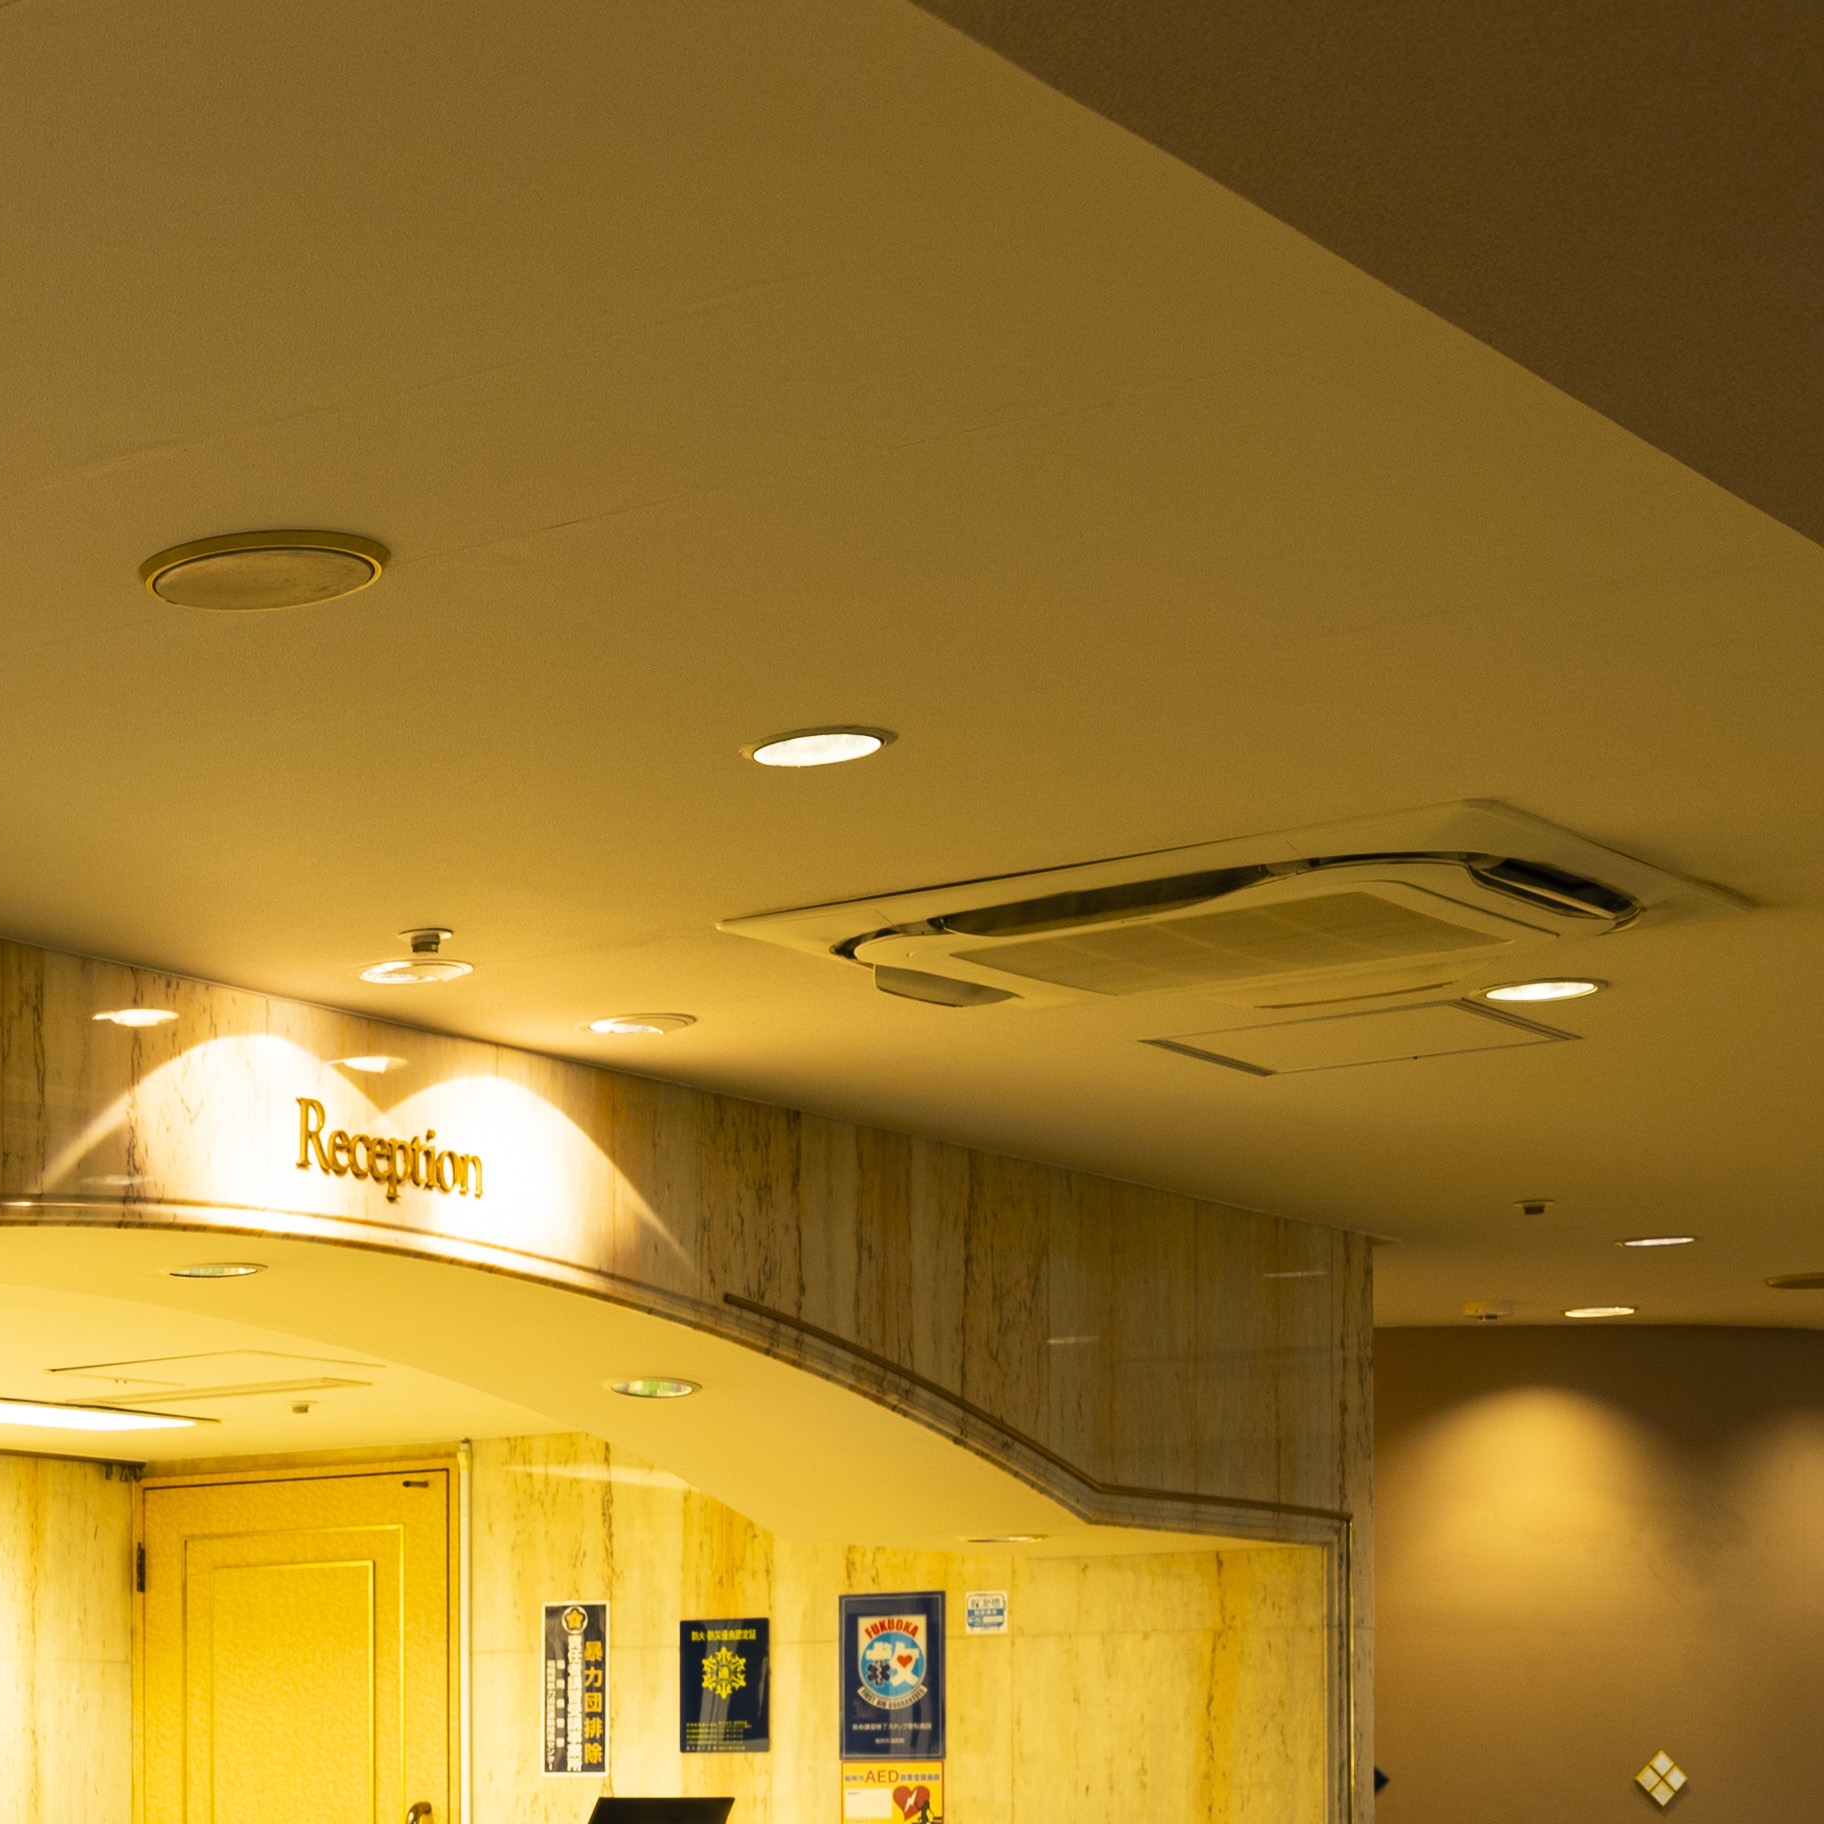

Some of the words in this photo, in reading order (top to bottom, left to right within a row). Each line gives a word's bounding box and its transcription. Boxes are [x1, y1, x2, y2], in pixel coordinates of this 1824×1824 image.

[296, 1097, 483, 1200] Reception
[865, 1618, 919, 1639] FUKUOKA
[584, 1641, 603, 1764] 暴力団排除
[865, 1770, 899, 1783] AED
